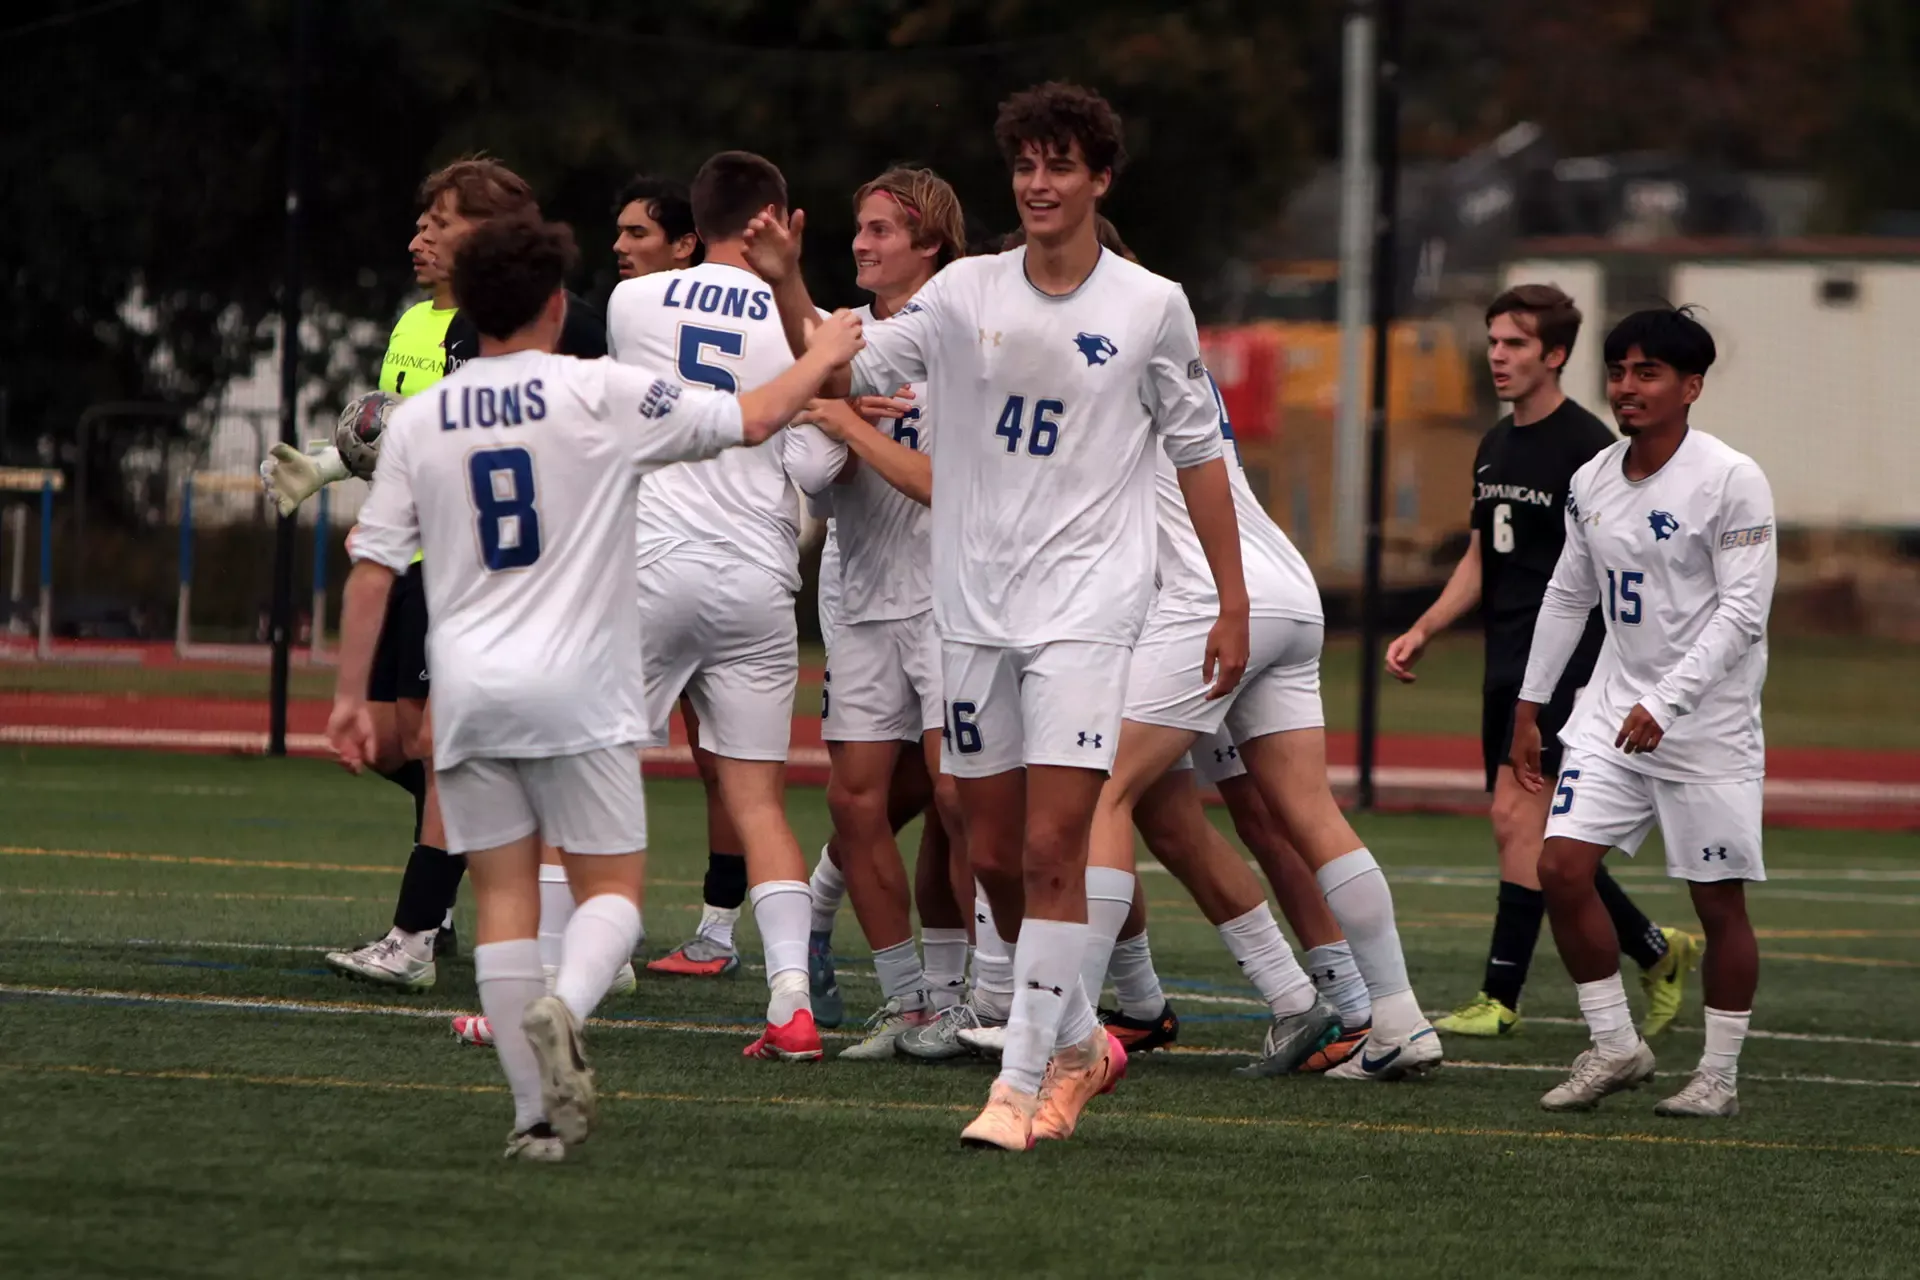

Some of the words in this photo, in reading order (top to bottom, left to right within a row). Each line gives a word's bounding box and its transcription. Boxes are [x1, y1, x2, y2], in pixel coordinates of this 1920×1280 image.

[662, 278, 772, 321] LIONS
[395, 371, 406, 394] 1
[677, 322, 745, 394] 5
[440, 379, 547, 431] LIONS
[995, 394, 1065, 457] 46
[467, 446, 544, 573] 8
[1493, 503, 1515, 553] 6
[1607, 569, 1644, 625] 15
[1552, 769, 1581, 816] 5
